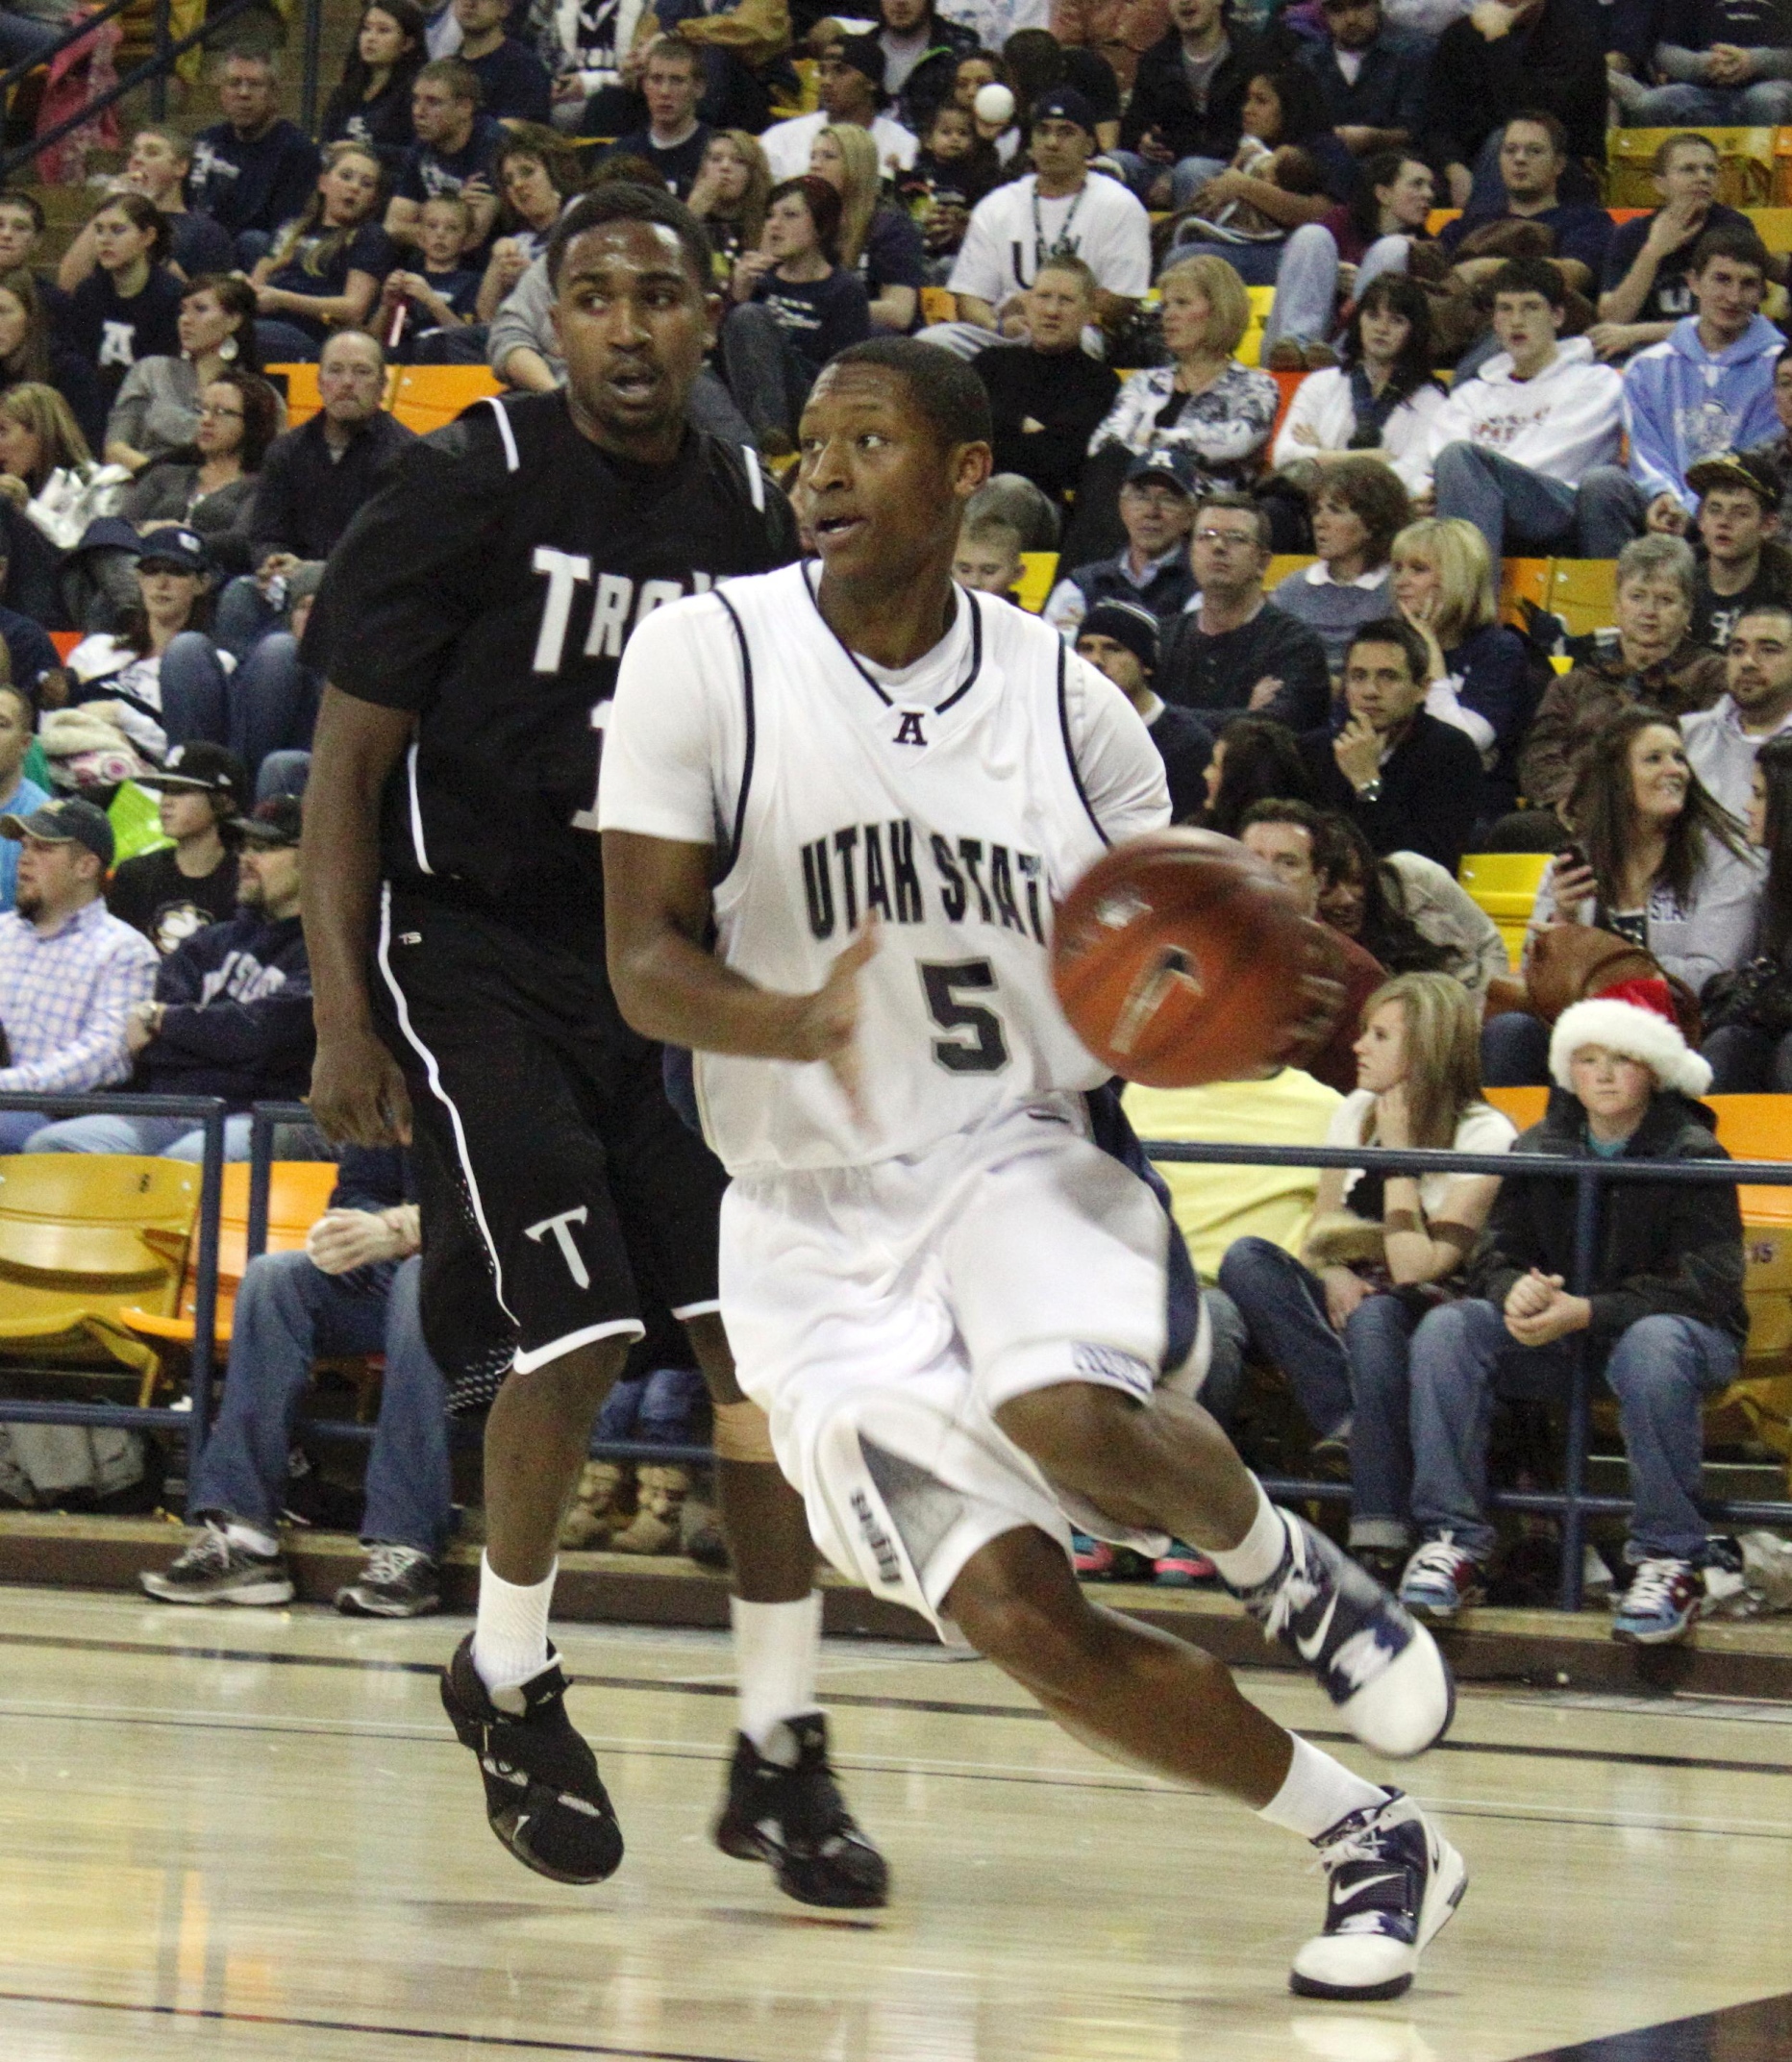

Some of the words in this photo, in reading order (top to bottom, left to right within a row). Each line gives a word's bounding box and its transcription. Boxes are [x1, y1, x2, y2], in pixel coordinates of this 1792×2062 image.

[99, 320, 137, 366] A
[892, 711, 929, 746] A
[801, 817, 926, 941] UTAH
[929, 831, 1050, 949] STAT
[914, 956, 1013, 1078] 5
[523, 1204, 591, 1291] T
